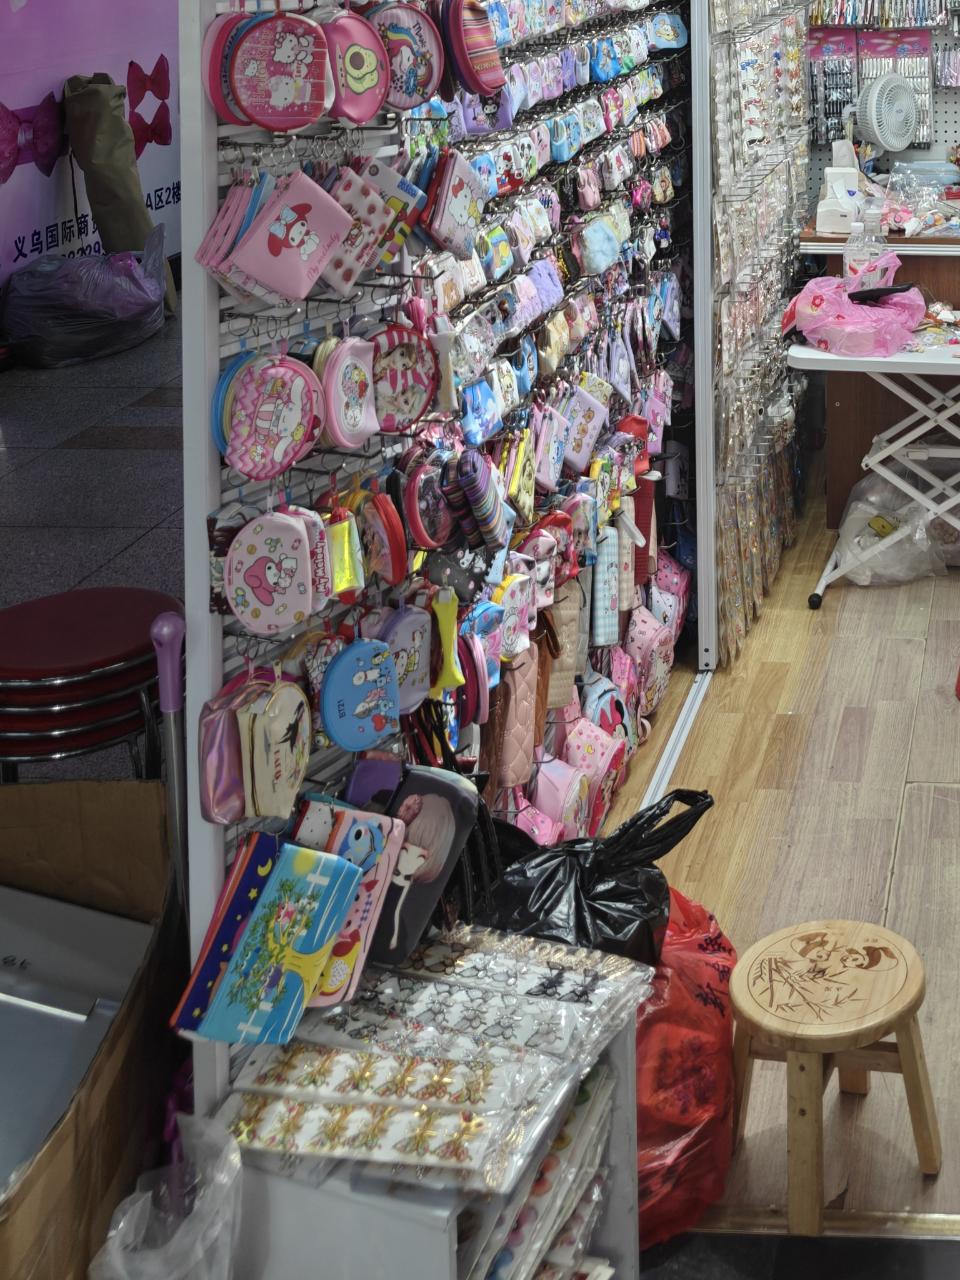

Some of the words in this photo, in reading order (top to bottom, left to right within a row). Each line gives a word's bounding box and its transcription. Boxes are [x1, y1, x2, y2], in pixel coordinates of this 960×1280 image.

[13, 213, 101, 263] 义乌国际商
